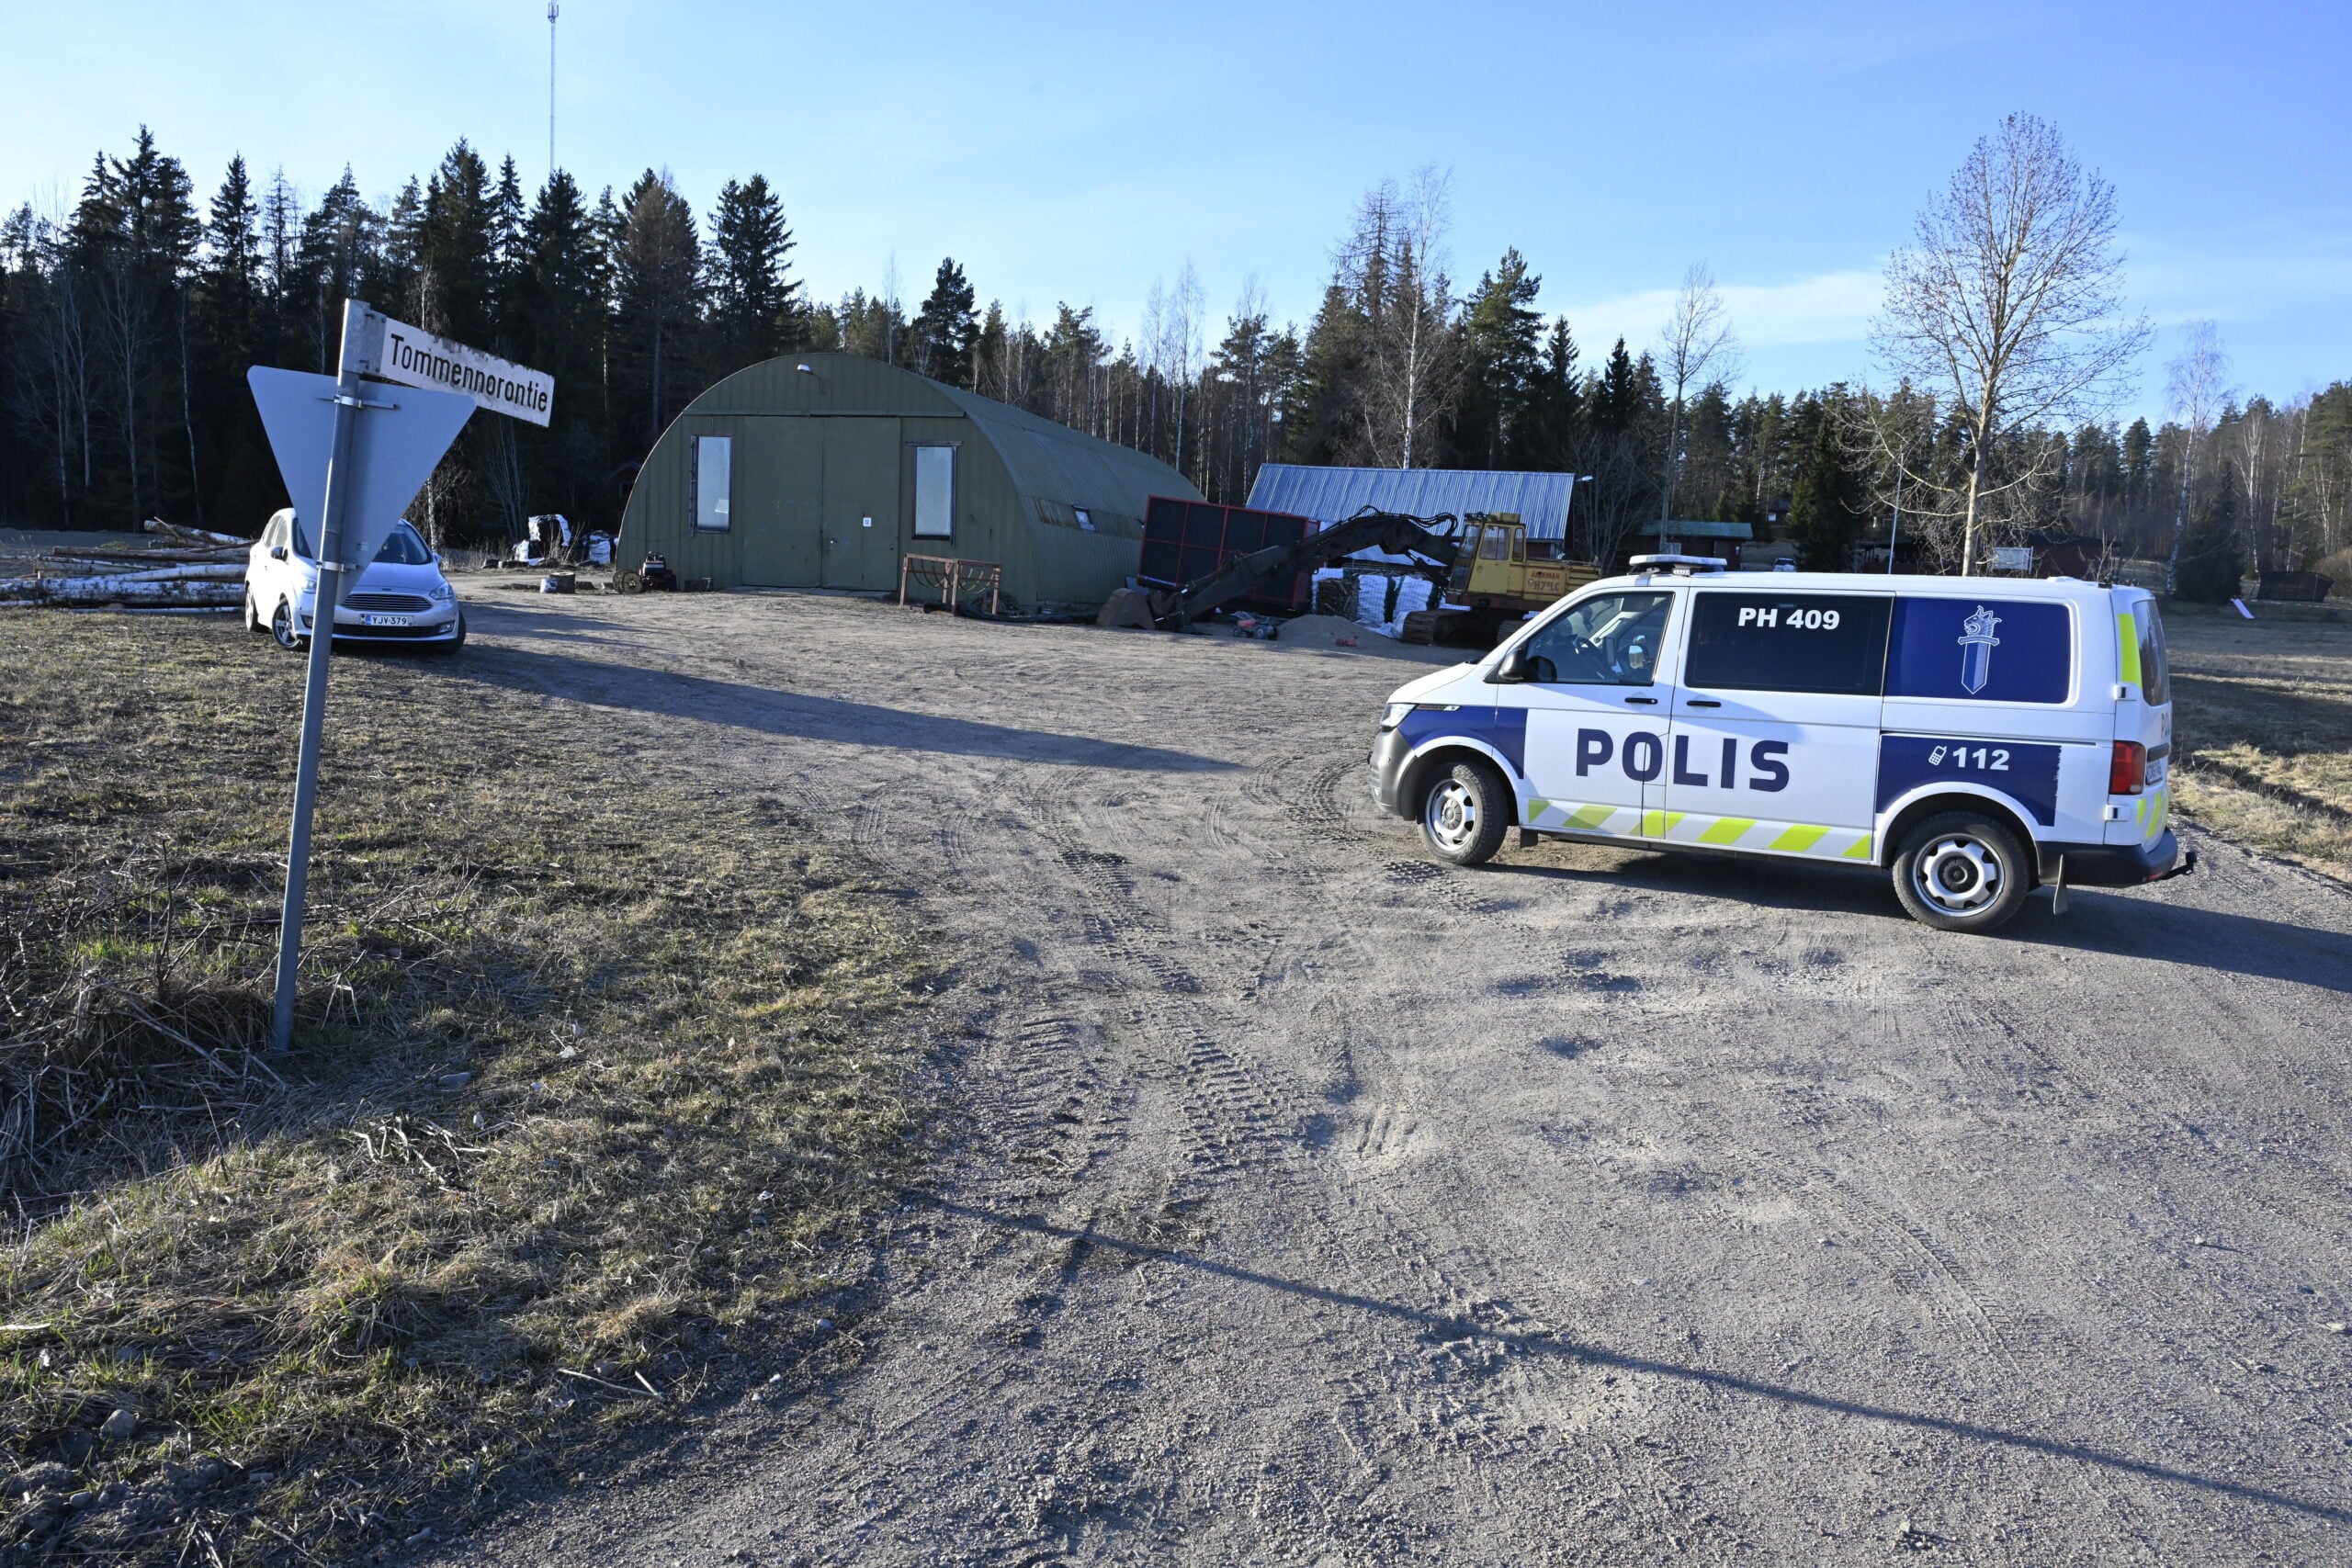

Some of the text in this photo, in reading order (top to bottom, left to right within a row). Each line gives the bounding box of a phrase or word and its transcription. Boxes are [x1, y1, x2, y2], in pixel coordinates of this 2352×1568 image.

[390, 333, 548, 412] Tommennorontie
[1738, 607, 1840, 630] PH 409
[1576, 728, 1790, 793] POLIS
[1952, 747, 2010, 771] 112
